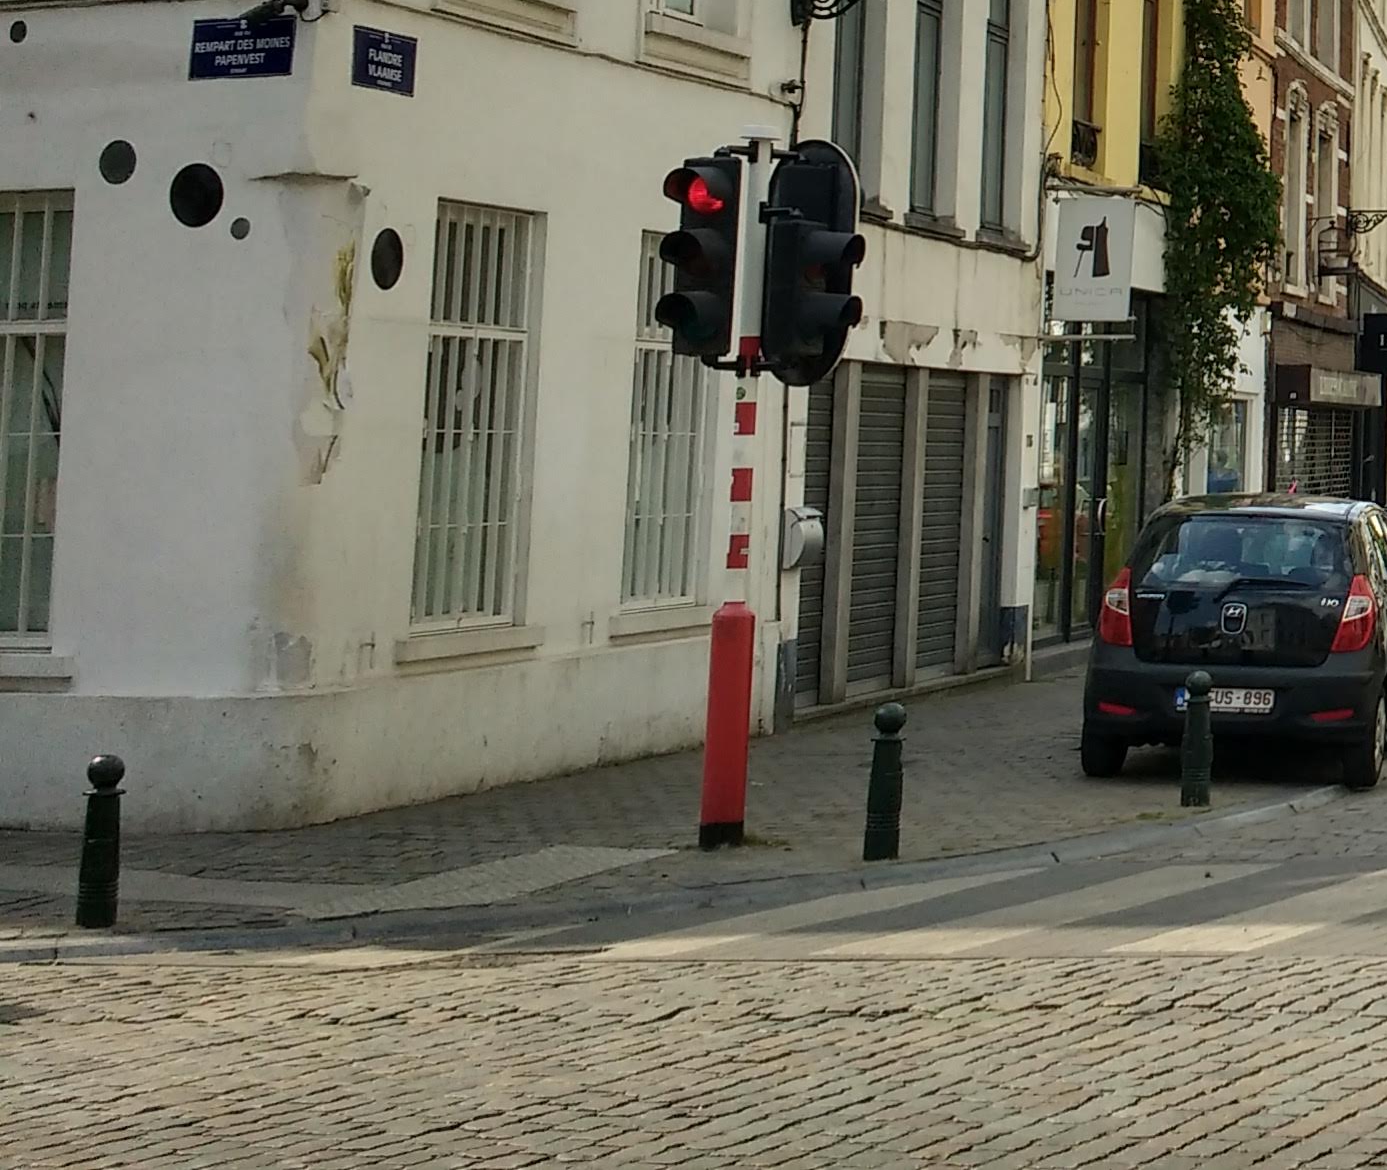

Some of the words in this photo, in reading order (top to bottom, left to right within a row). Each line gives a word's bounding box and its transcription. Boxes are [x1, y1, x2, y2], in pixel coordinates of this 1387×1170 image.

[194, 40, 235, 54] REMPART
[236, 38, 254, 50] DES
[255, 36, 291, 49] MOINES
[214, 52, 266, 66] PAPENVEST
[368, 48, 403, 67] FLANDRE
